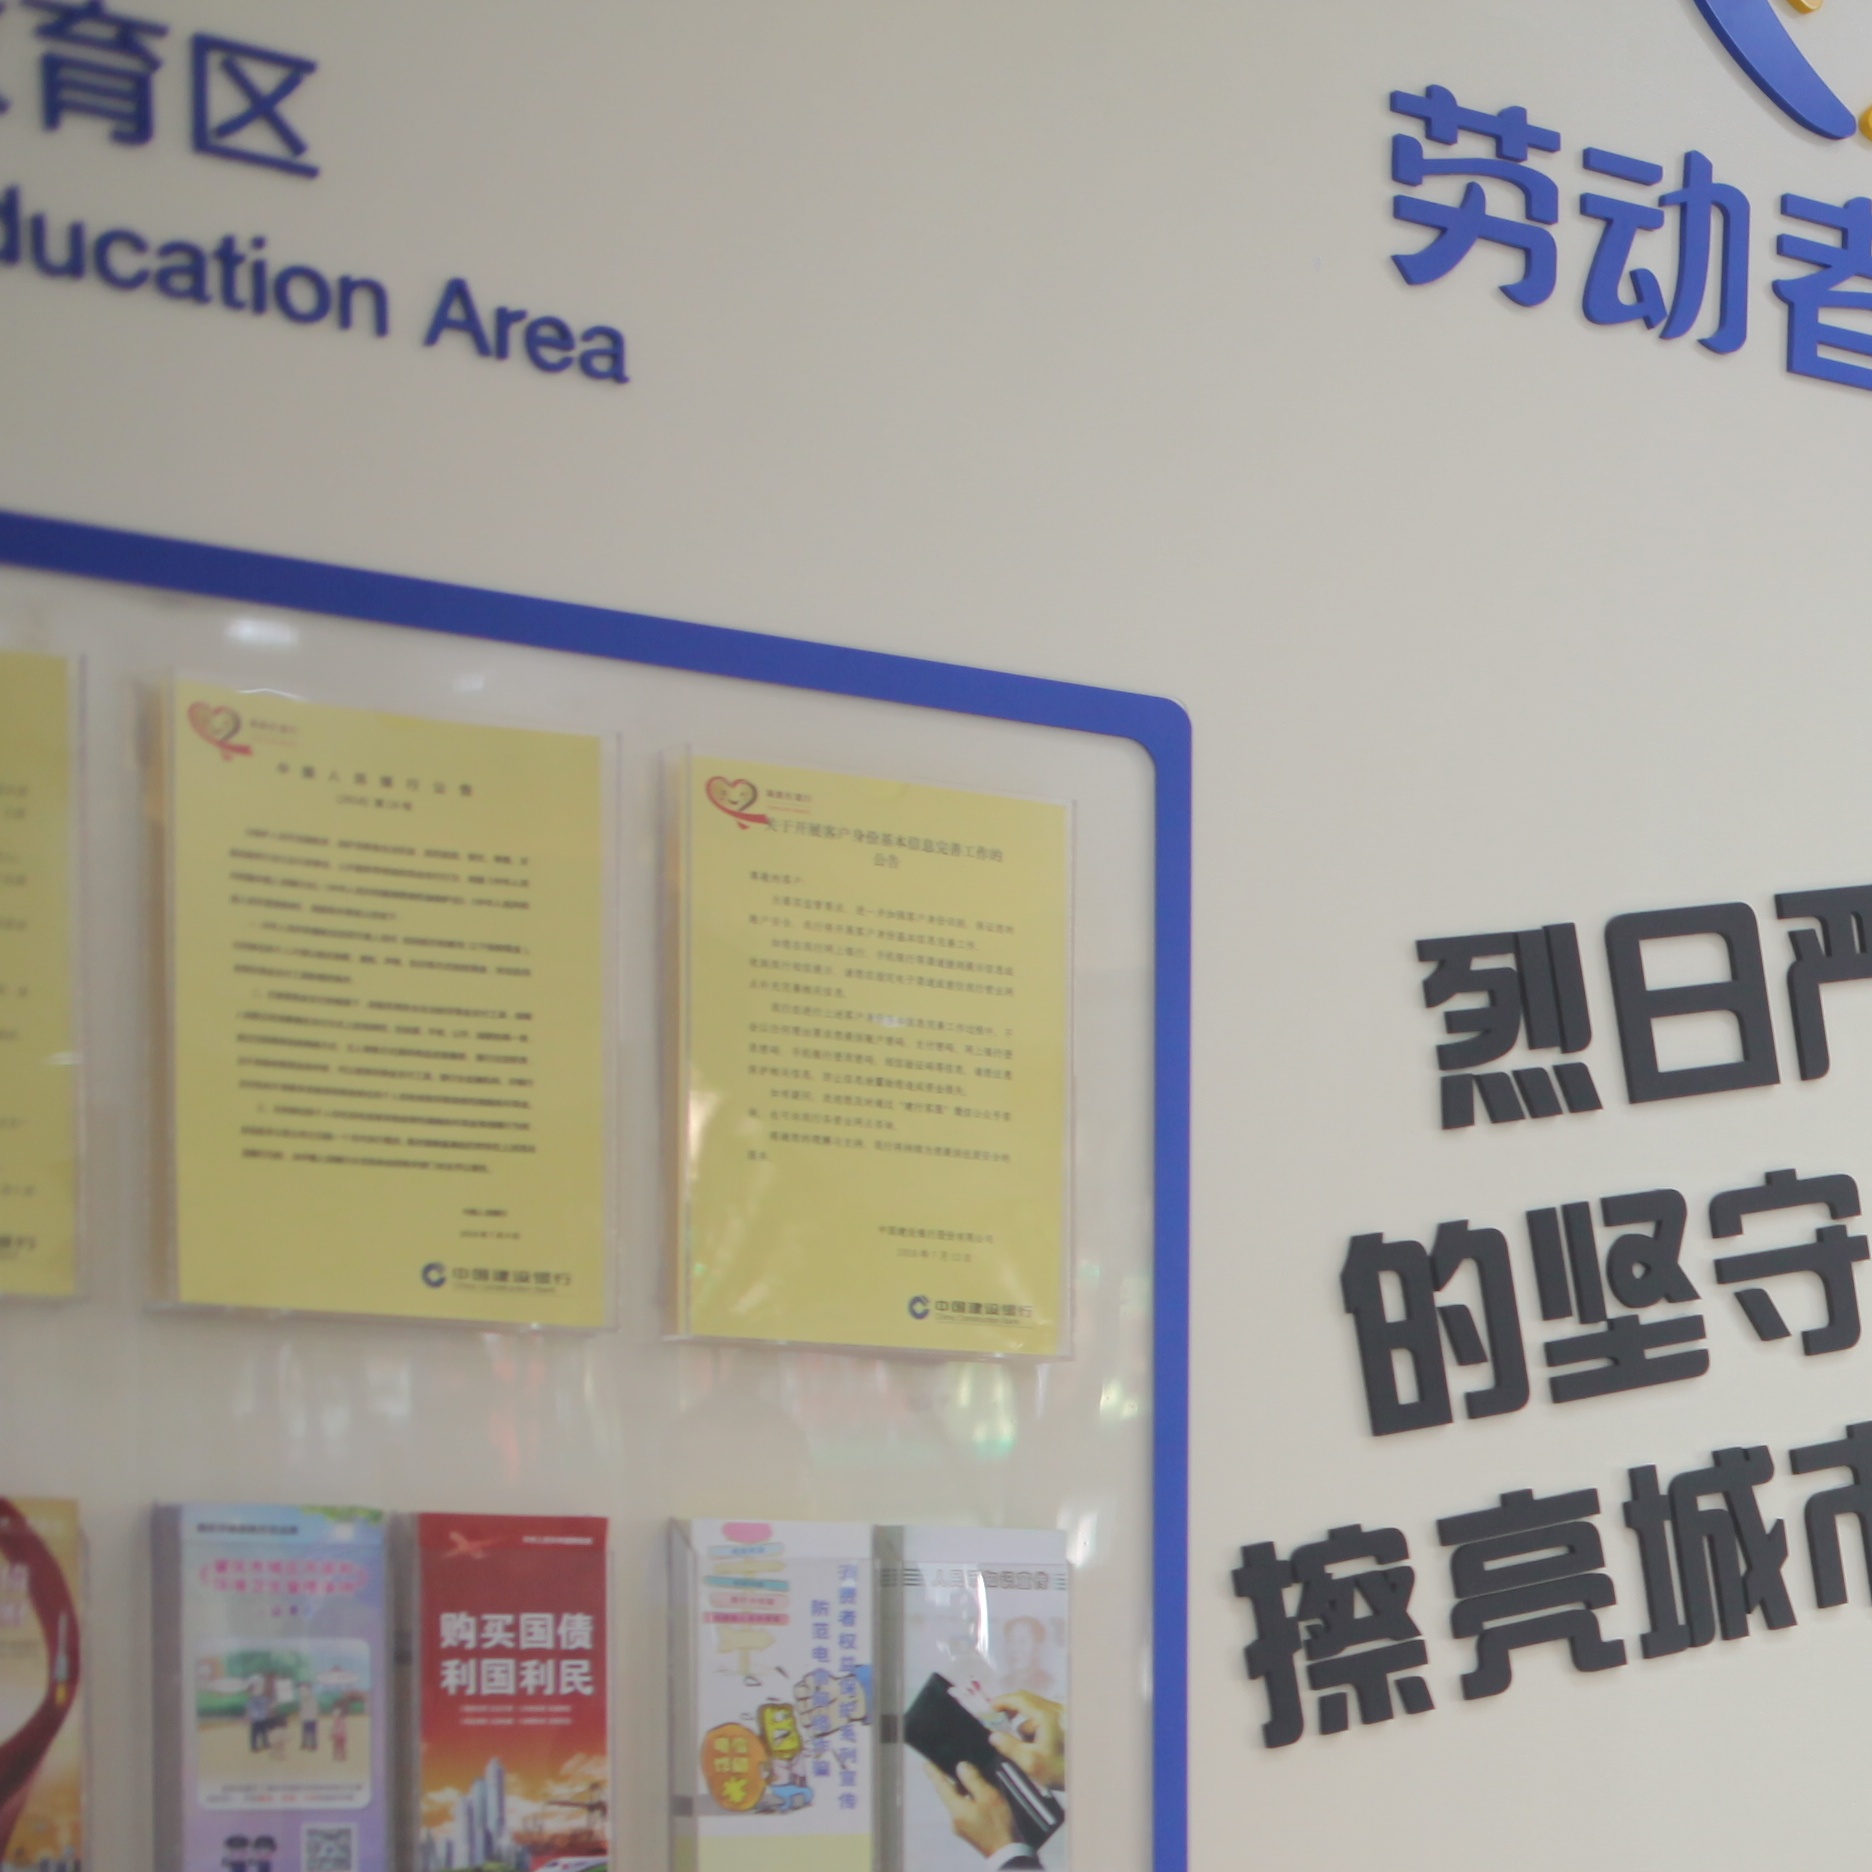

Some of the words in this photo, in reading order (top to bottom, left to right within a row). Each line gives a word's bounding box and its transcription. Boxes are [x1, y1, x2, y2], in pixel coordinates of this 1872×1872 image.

[0, 0, 320, 179] 育区
[423, 277, 630, 384] Area
[1339, 1168, 1871, 1438] 的坚守
[439, 1611, 594, 1650] 购买国债
[439, 1658, 595, 1696] 利国利民
